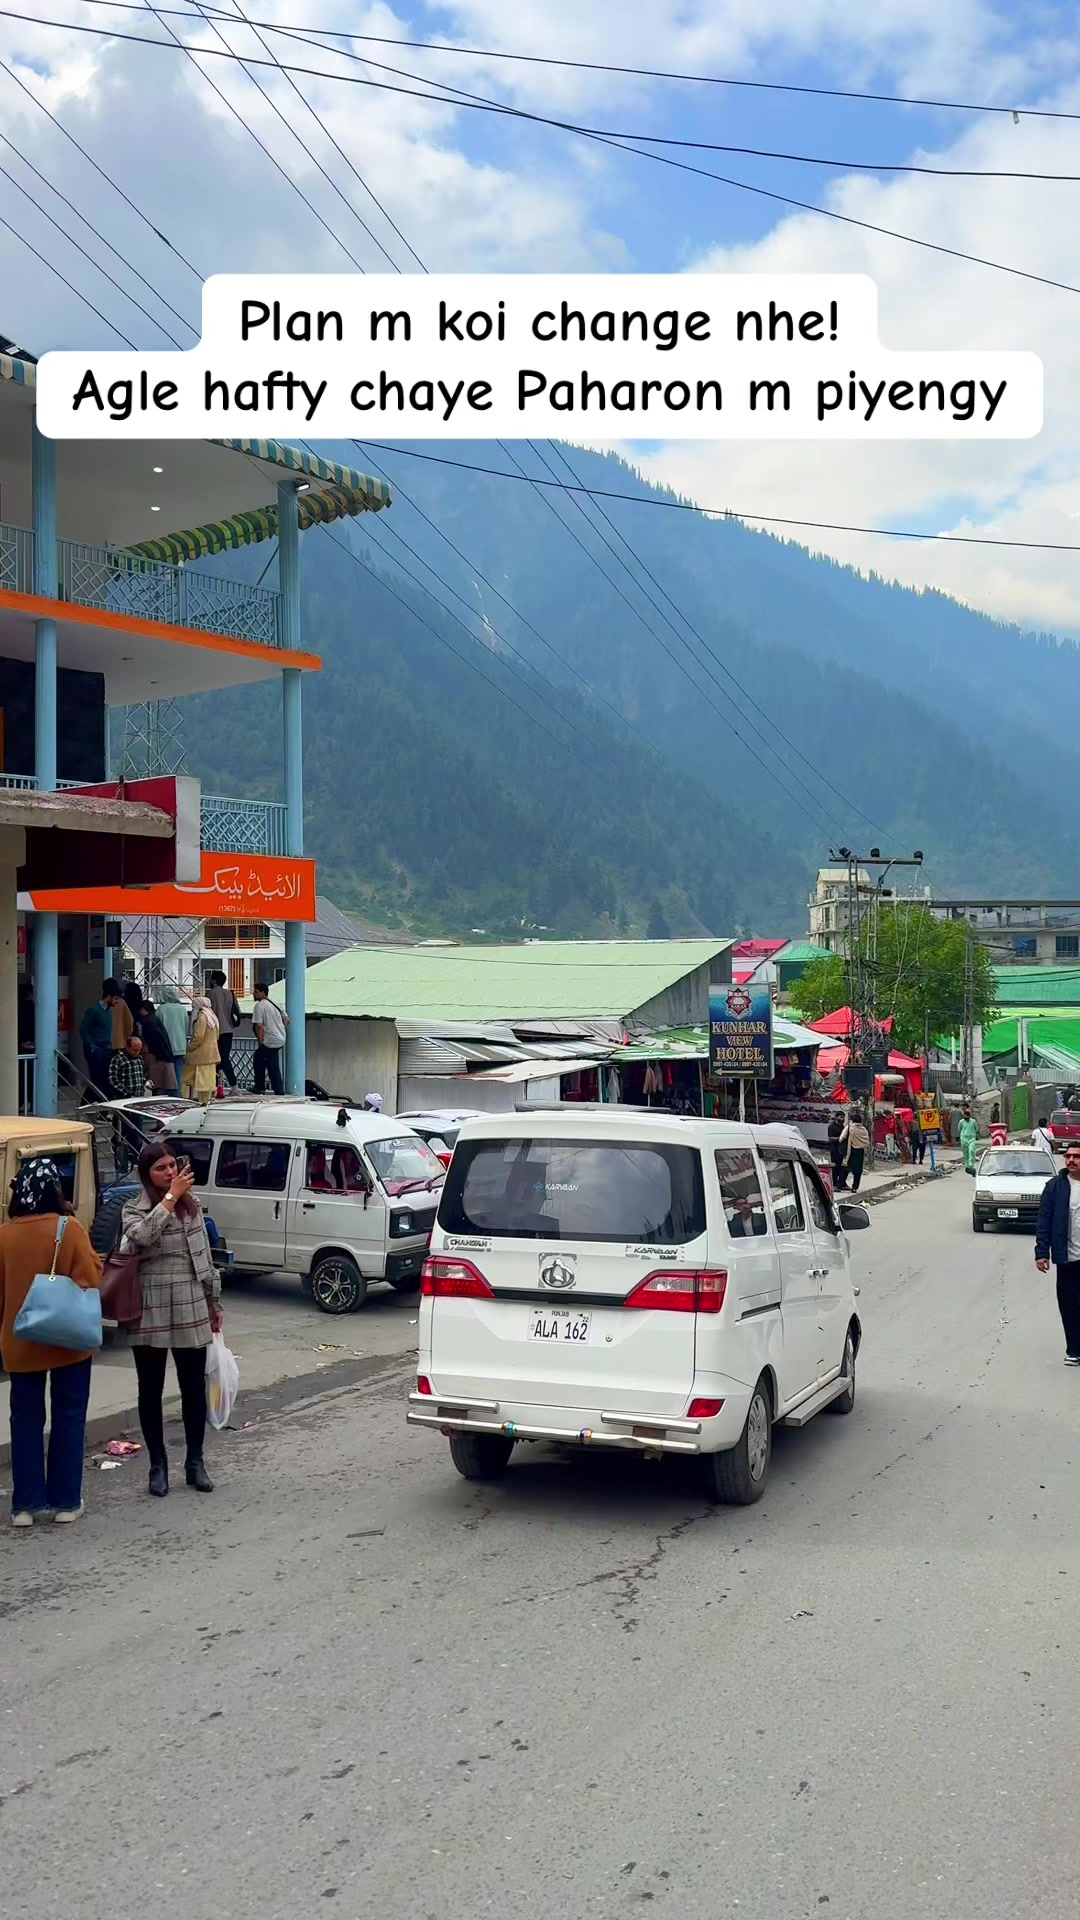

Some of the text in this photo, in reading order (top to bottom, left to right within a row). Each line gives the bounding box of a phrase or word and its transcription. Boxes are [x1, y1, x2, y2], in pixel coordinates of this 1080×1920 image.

[173, 866, 244, 900] بینک
[711, 1021, 767, 1034] KUNHAR
[726, 1035, 754, 1046] VIEW
[716, 1047, 764, 1061] HOTEL
[533, 1320, 588, 1340] ALA 162
